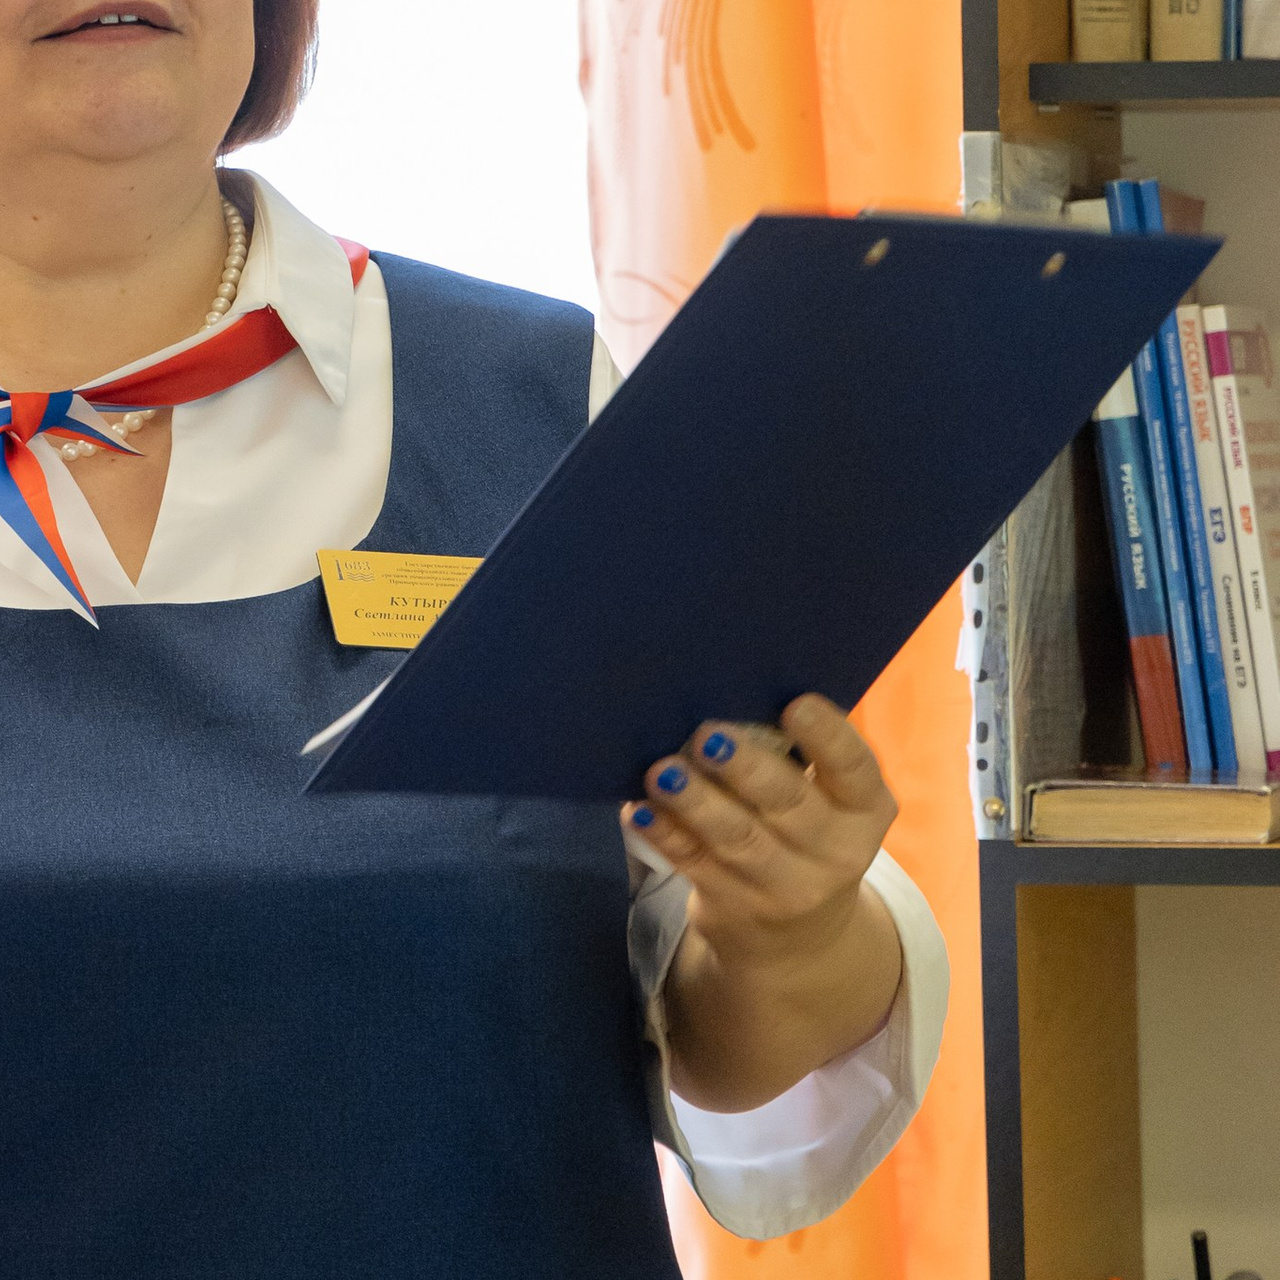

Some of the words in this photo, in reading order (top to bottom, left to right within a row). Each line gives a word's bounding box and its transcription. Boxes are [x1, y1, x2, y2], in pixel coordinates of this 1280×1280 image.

[1182, 318, 1204, 395] РУССКИЙ
[1120, 463, 1141, 537] РУССКИЙ
[1131, 543, 1147, 589] ЯЗЫК
[1210, 507, 1226, 543] ЕГЭ
[344, 560, 371, 571] 683
[354, 608, 426, 622] Светлана
[390, 596, 451, 610] КУТЫР
